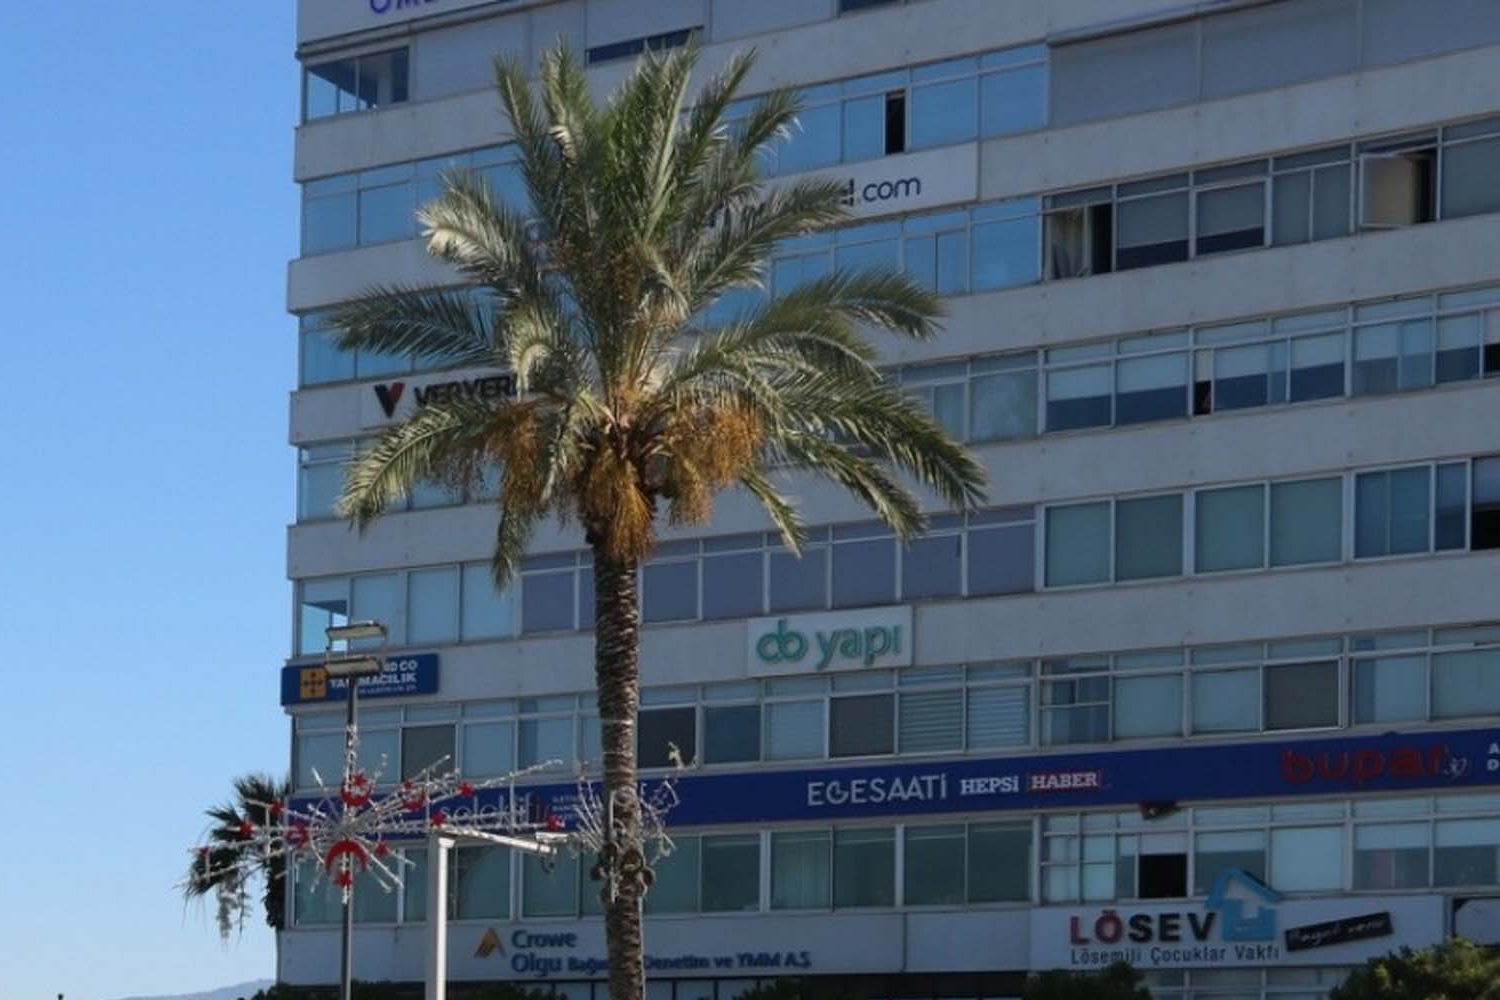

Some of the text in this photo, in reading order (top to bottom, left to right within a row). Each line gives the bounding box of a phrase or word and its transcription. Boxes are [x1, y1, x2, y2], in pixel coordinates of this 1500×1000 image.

[815, 624, 903, 670] yapı
[1031, 771, 1098, 790] HABER
[511, 930, 577, 948] Crowe
[1070, 910, 1217, 945] LÖSEV
[511, 953, 562, 977] Olgu
[1150, 946, 1227, 966] Çocuklar
[1234, 944, 1280, 961] Vakfı
